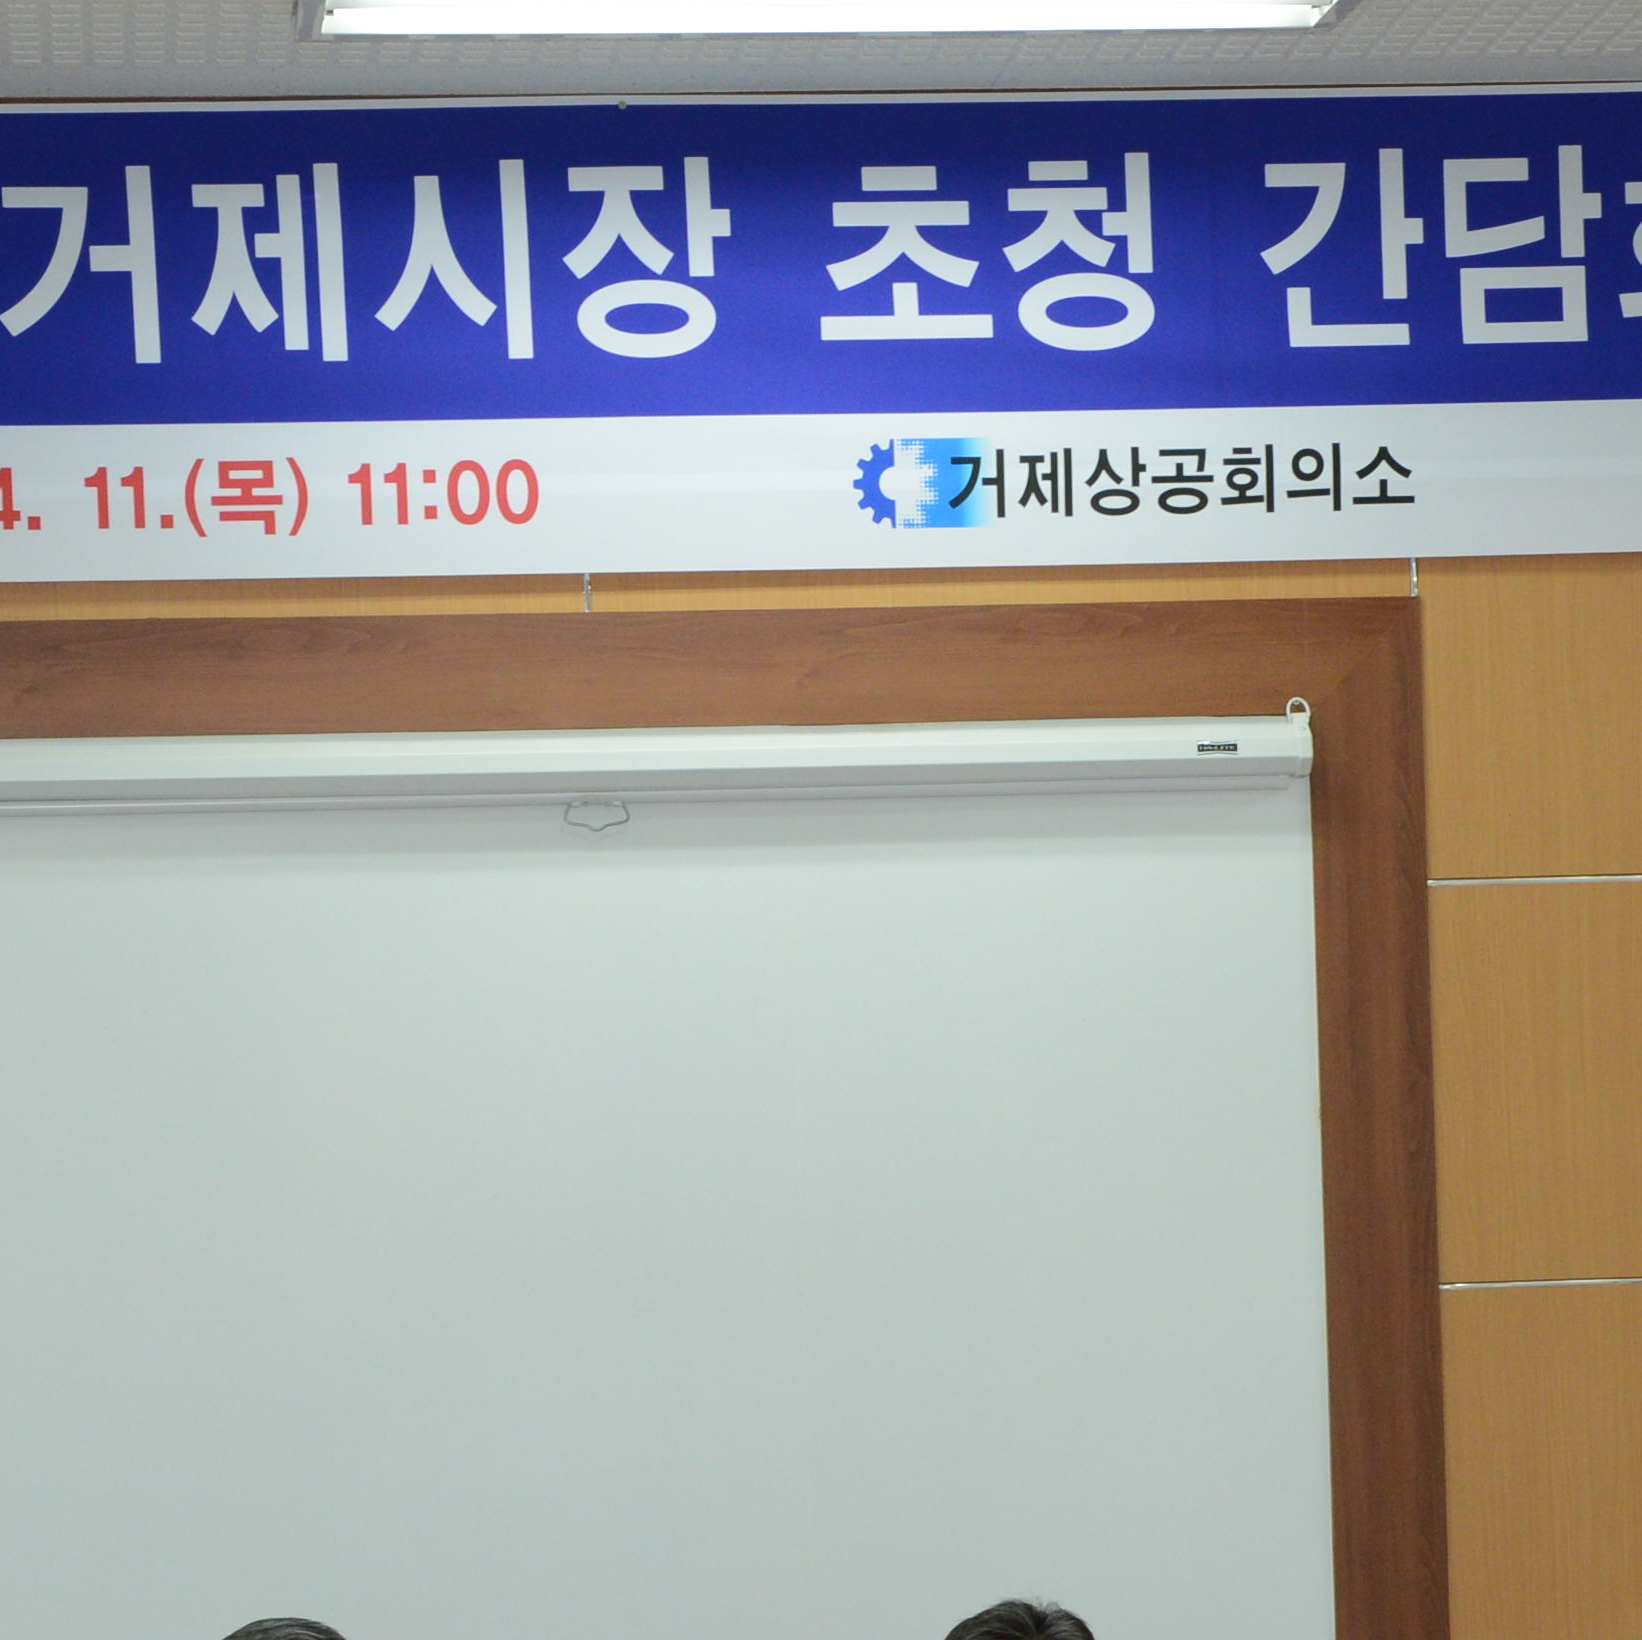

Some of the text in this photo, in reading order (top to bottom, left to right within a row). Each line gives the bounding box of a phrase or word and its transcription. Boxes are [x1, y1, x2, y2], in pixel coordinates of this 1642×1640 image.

[0, 157, 731, 363] 거제시장
[820, 153, 1156, 351] 초청
[84, 457, 309, 537] 11.(목)
[348, 459, 540, 526] 11:00
[949, 442, 1415, 518] 거제상공회의소
